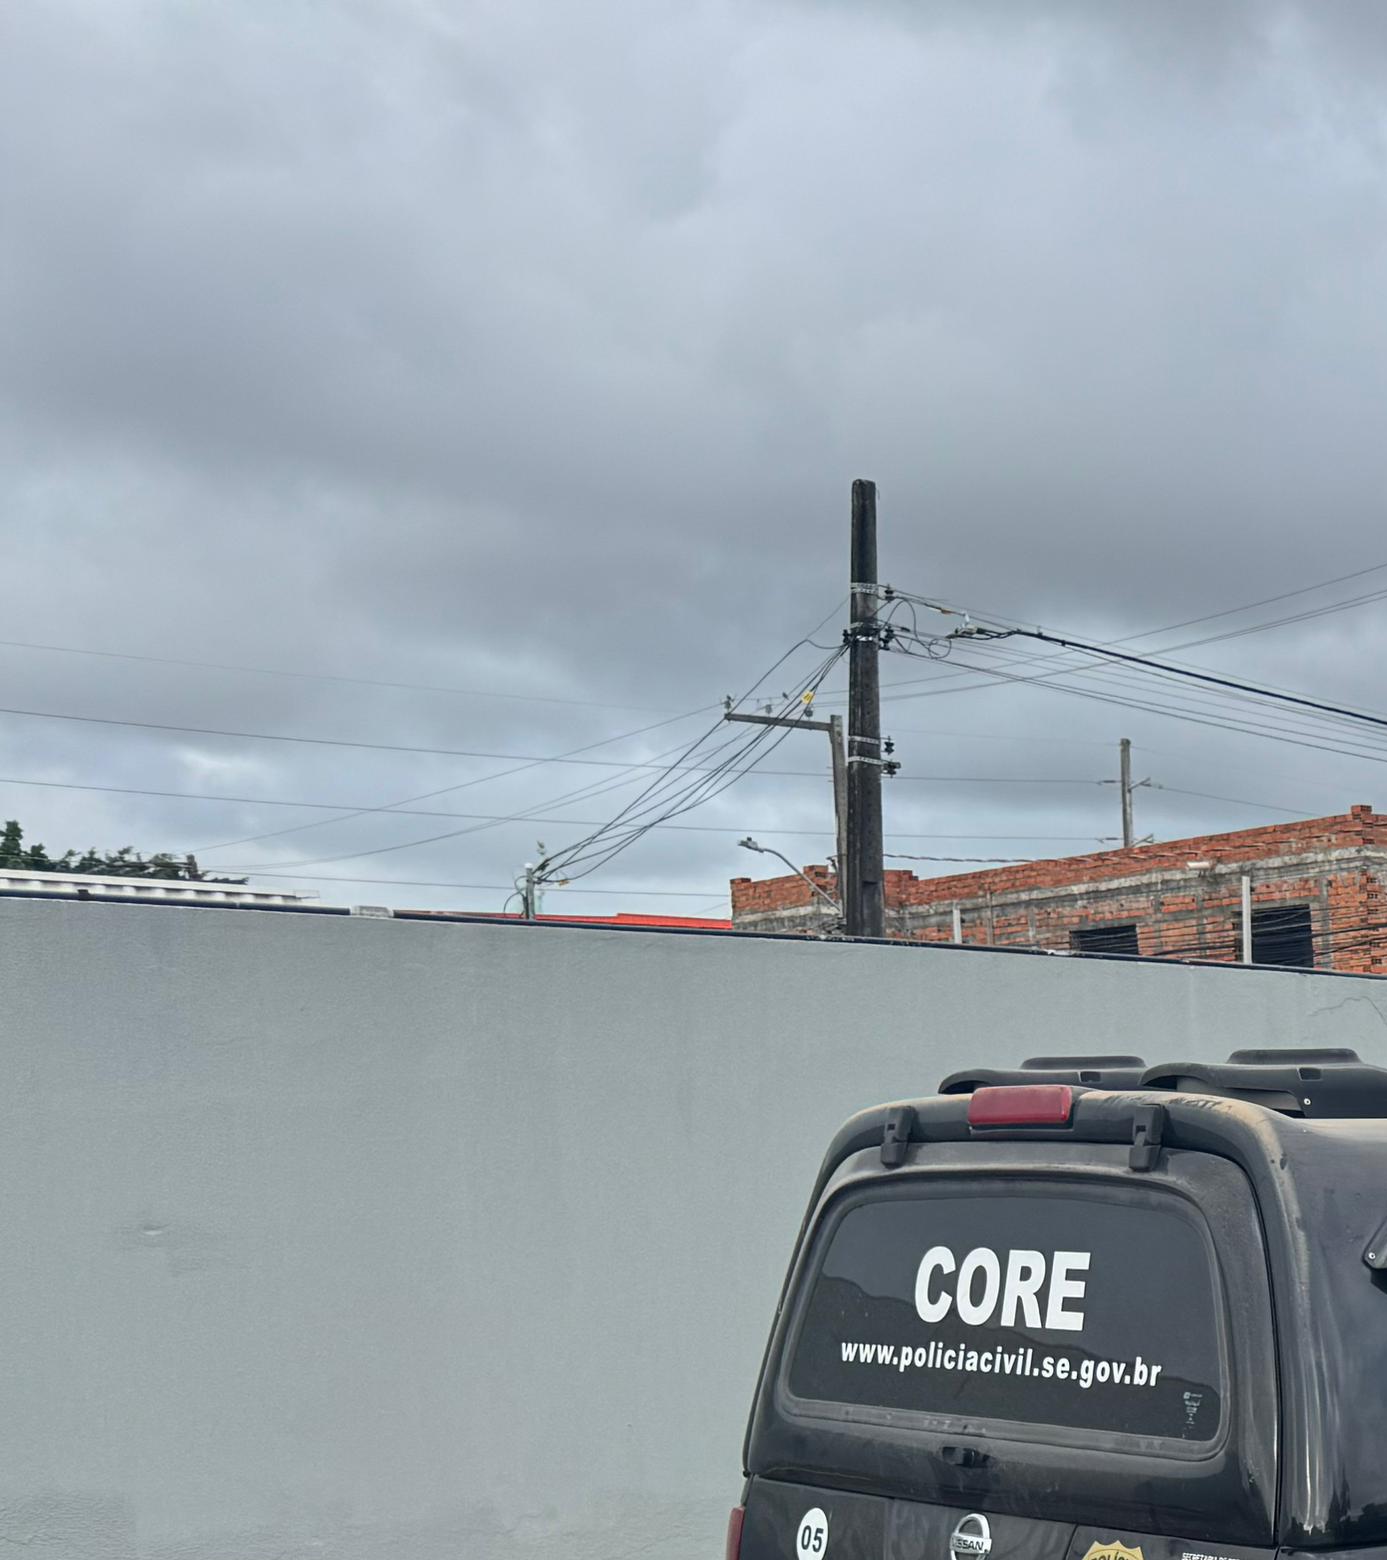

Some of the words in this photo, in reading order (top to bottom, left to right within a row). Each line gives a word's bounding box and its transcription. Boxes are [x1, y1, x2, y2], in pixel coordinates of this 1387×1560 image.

[915, 1245, 1091, 1331] CORE
[841, 1340, 1162, 1389] www.policiacivil.se.gov.br
[801, 1525, 824, 1553] 05
